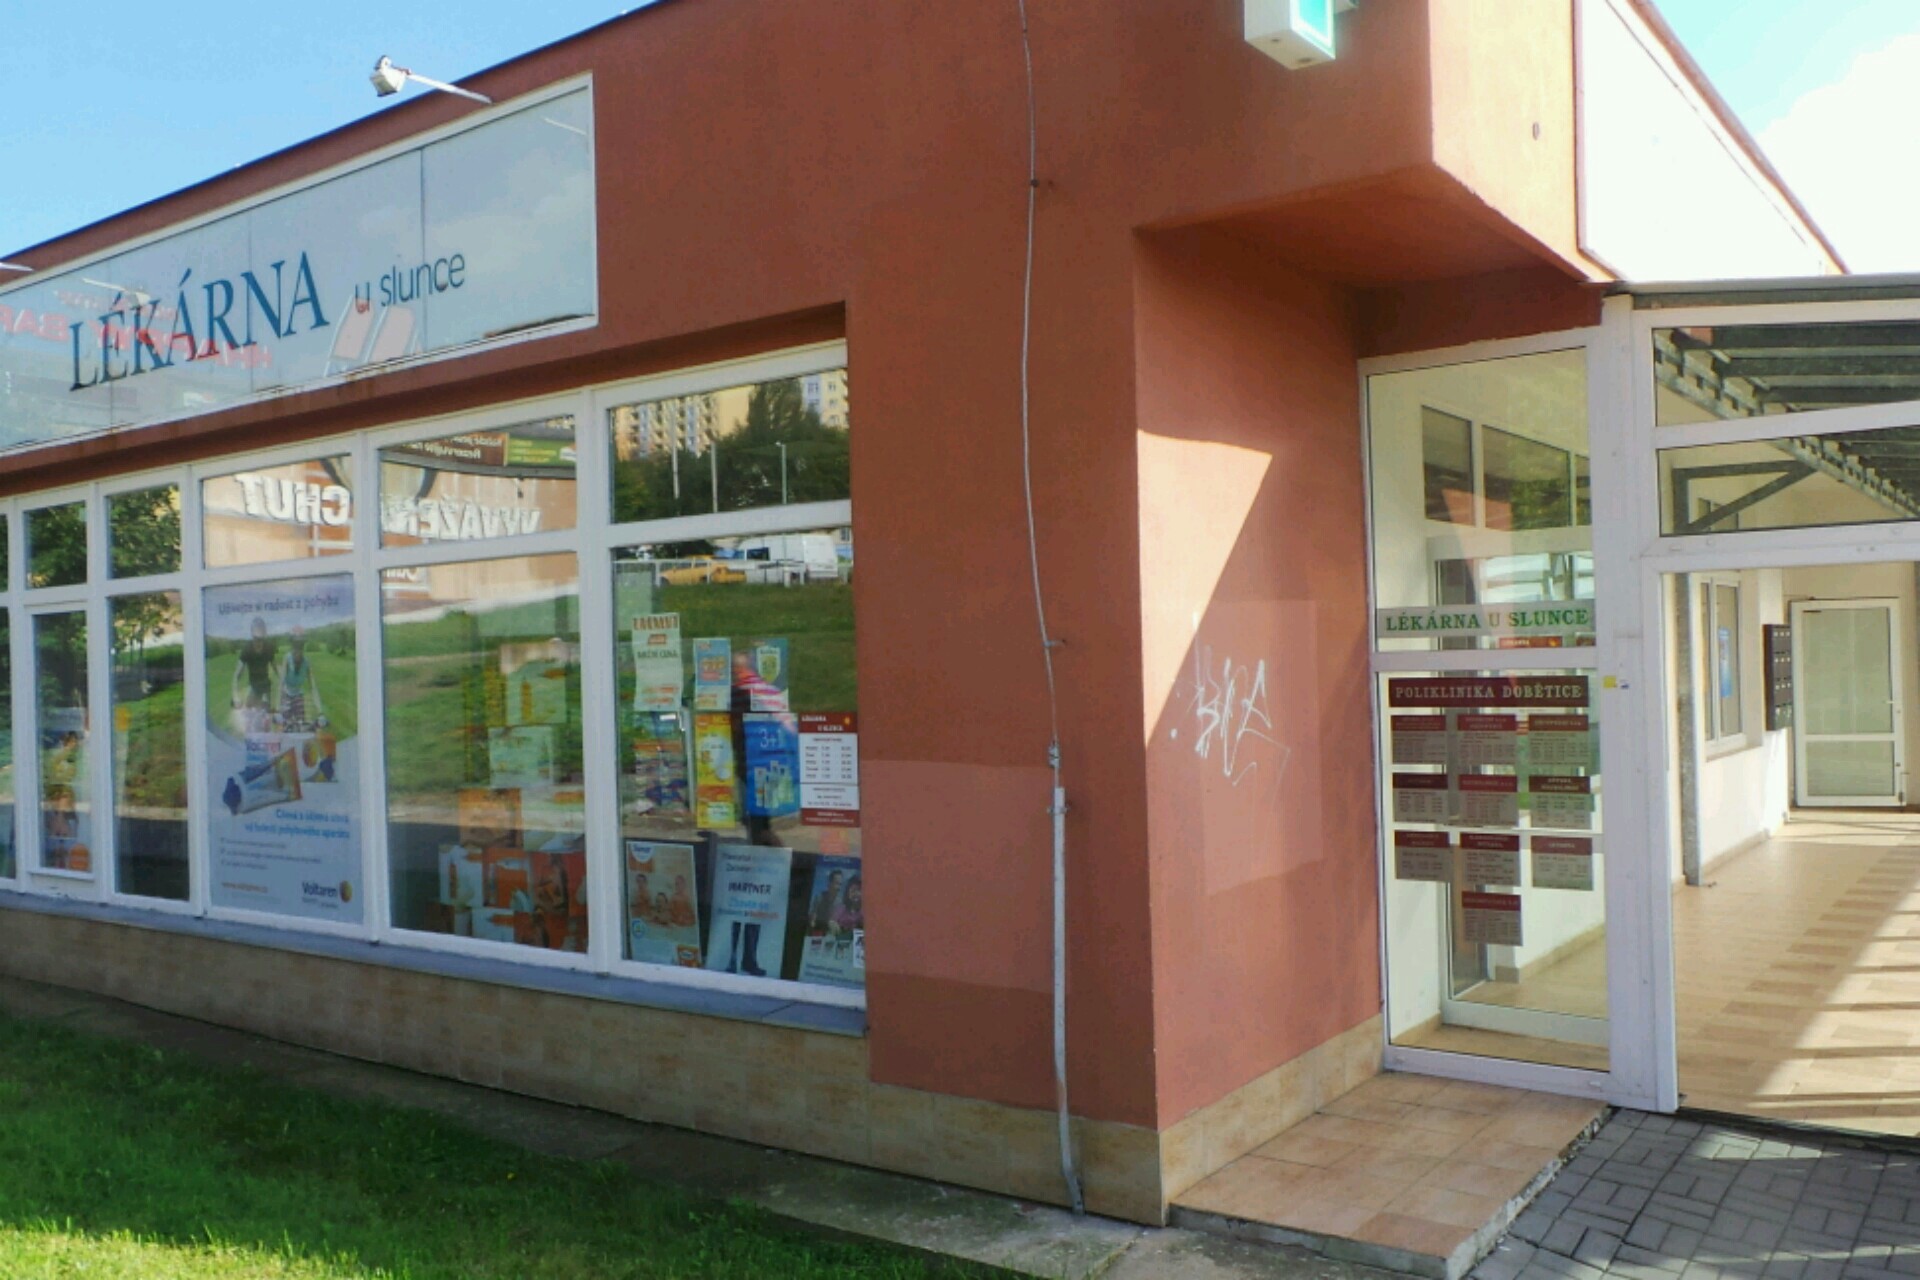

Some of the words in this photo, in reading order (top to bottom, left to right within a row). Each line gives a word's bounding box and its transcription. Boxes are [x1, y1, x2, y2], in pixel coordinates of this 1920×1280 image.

[355, 283, 372, 313] u
[380, 251, 466, 308] slunce
[69, 250, 330, 392] LÉKÁRNA
[1386, 610, 1482, 631] LÉKÁRNA
[1489, 613, 1501, 628] U
[1508, 609, 1589, 627] SLUNCE
[1395, 685, 1495, 699] POLIKLINIKA
[1502, 682, 1583, 699] DOBĚTICE
[302, 881, 338, 898] Voltaren
